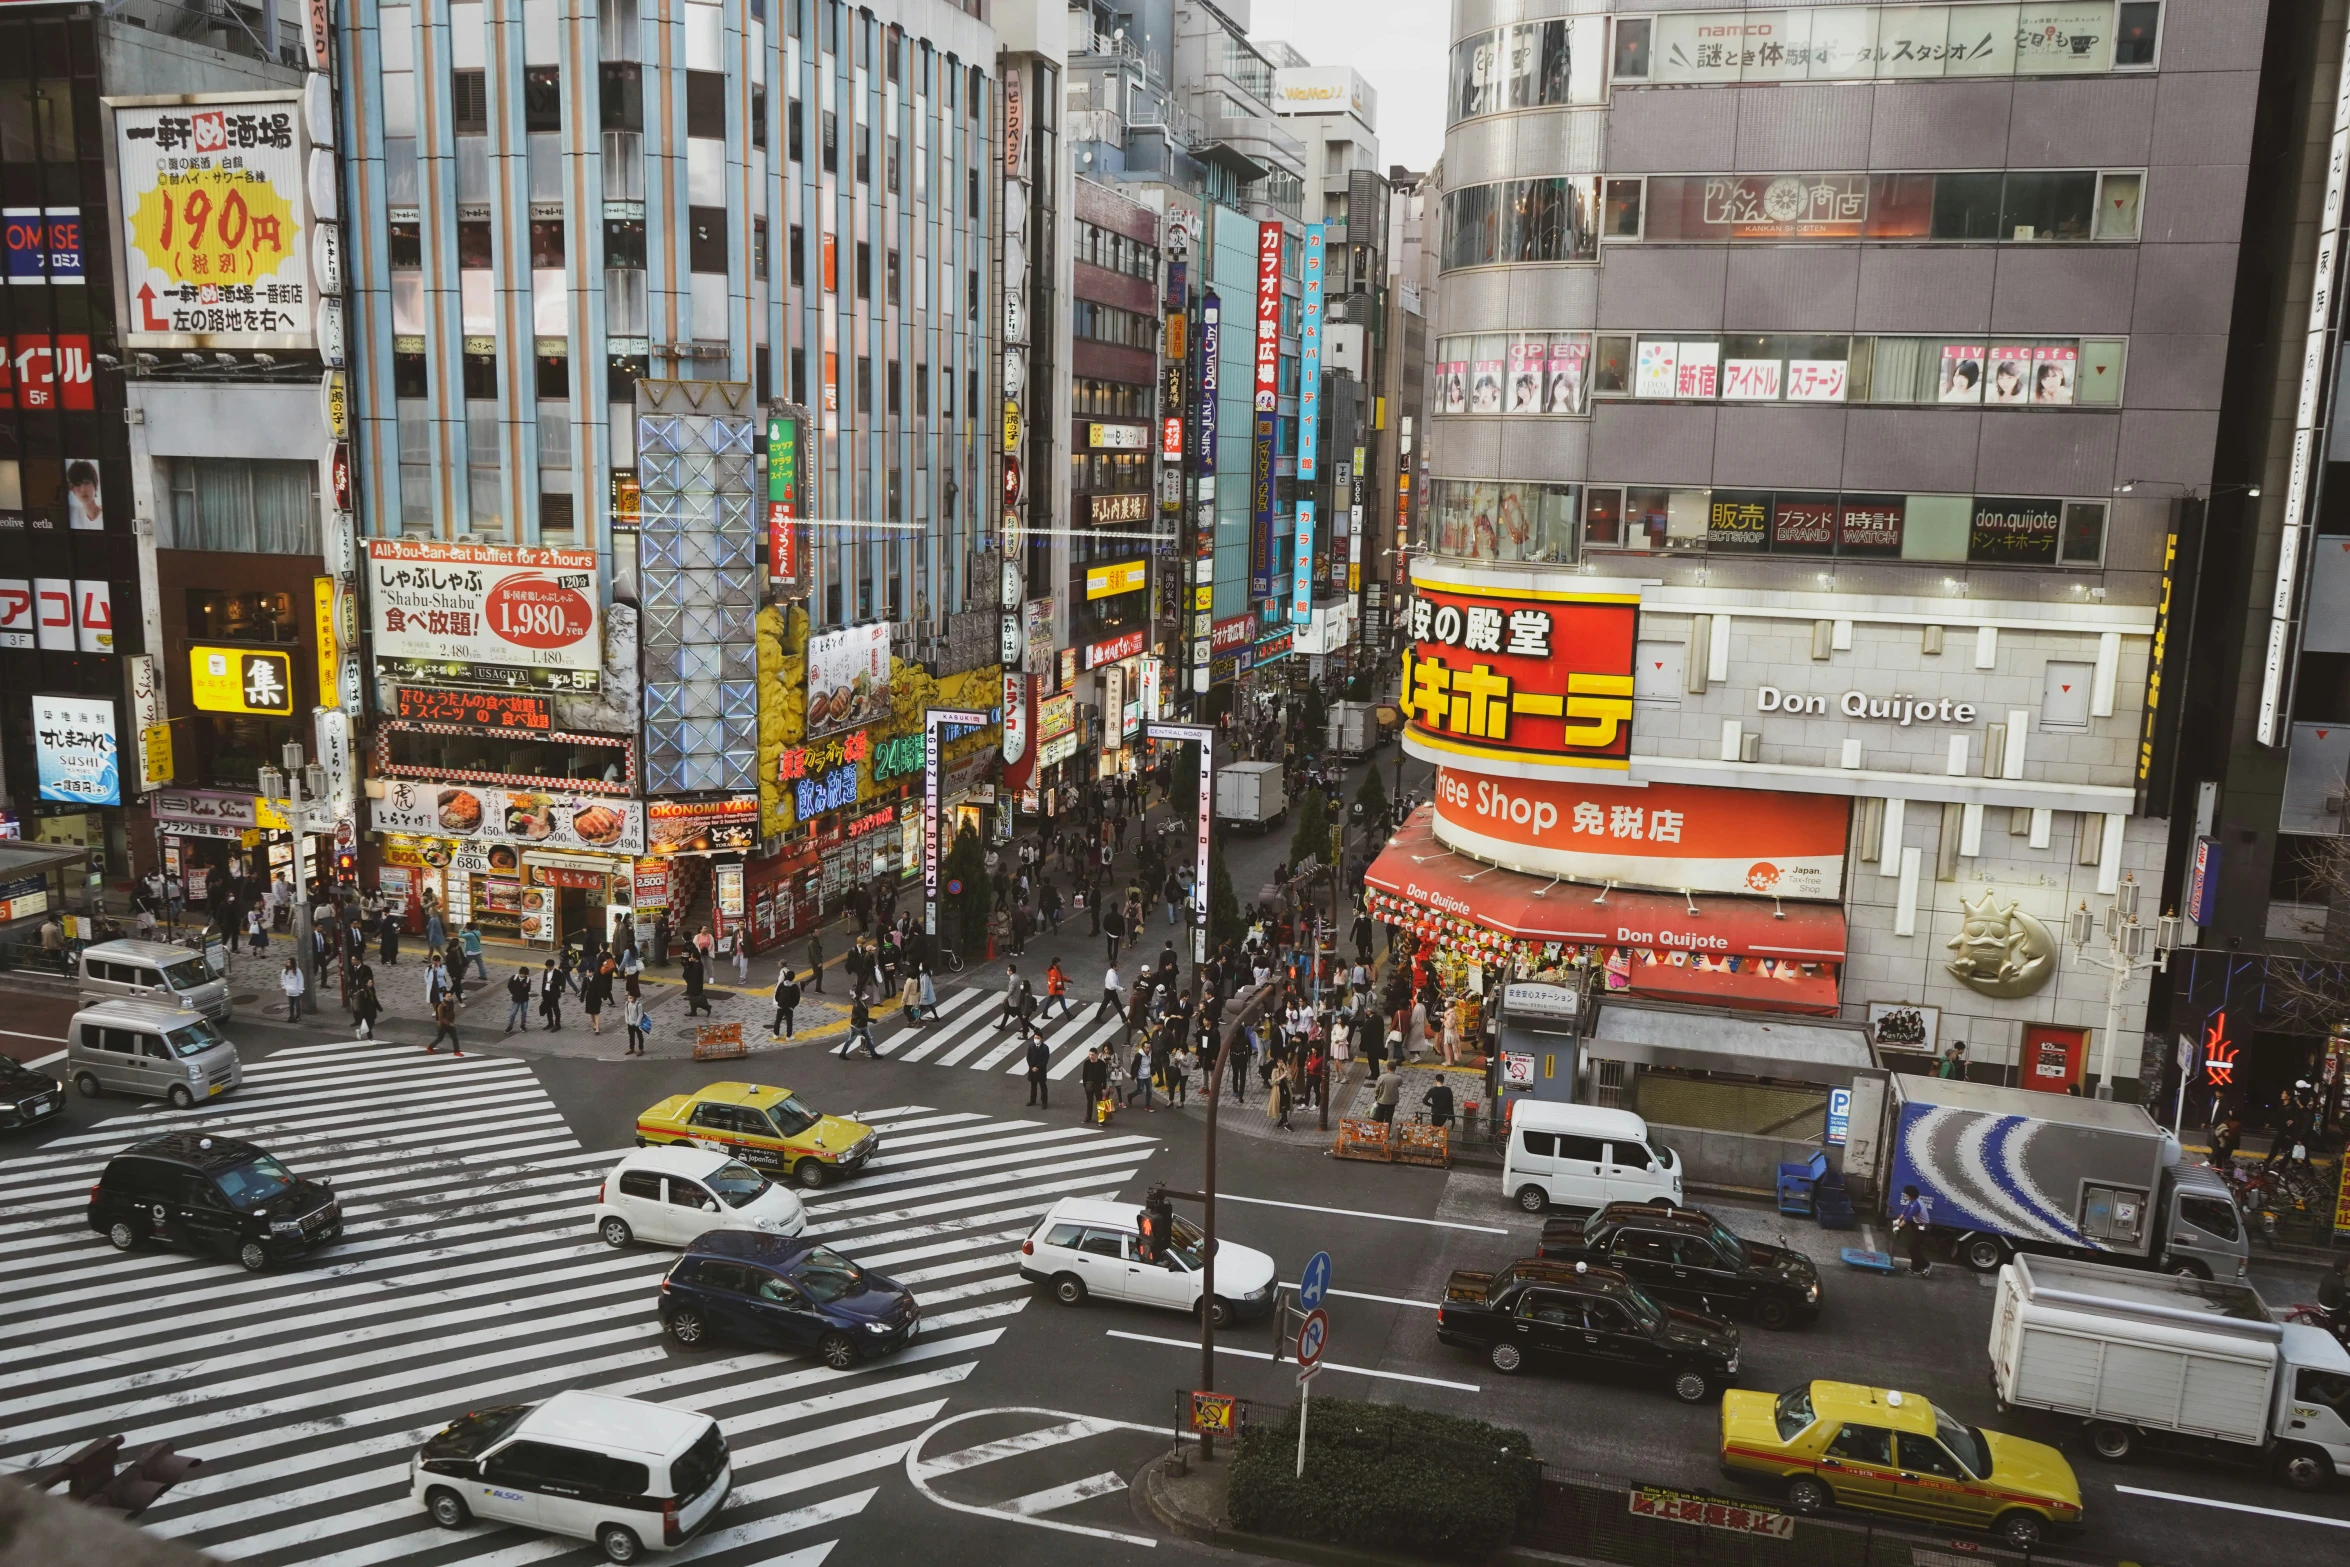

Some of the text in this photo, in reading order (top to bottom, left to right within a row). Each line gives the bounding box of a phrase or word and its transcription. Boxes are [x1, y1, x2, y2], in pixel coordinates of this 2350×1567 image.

[1698, 24, 1773, 37] namco
[159, 188, 282, 252] 190円
[1745, 224, 1781, 233] KANKAN
[1258, 228, 1279, 384] カラオケ歌広場
[173, 308, 295, 332] 左の路地を右へ
[1301, 234, 1320, 469] カラオケ&パーティー館
[1511, 344, 1587, 358] OPEN
[1678, 364, 1845, 397] 新宿 アイドル ステージ
[29, 390, 48, 405] 5F
[1006, 415, 1019, 440] 虎の子
[771, 471, 793, 480] スイーツ
[1711, 502, 1765, 531] 販売
[1777, 510, 1899, 531] ブランド 時計
[1777, 527, 1898, 545] BRAND WATCH
[540, 552, 550, 564] 2
[1296, 510, 1311, 613] カラオケ館
[380, 565, 484, 592] しゃぶしゃぶ
[499, 602, 584, 638] 1,980 yen
[1408, 594, 1551, 657] 安の殿堂
[9, 634, 26, 646] 3F
[244, 659, 284, 705] 集
[572, 672, 598, 689] 5F
[1005, 677, 1018, 731] トラノコ
[1399, 646, 1635, 749] キホーテ
[1757, 685, 1976, 727] Don Quijote
[1150, 728, 1202, 738] CENTRAL ROAD
[60, 755, 99, 768] SUSHI
[629, 803, 640, 837] かつ丼
[650, 800, 758, 818] OKONOMI YAKI
[1475, 780, 1558, 836] Shop
[1572, 801, 1684, 844] 免税店
[927, 832, 936, 871] ROAD
[1788, 876, 1822, 886] Tax-free
[1799, 884, 1821, 895] Shop
[1406, 882, 1470, 917] Don Quijote
[1616, 927, 1729, 951] Don Quijote
[1833, 1093, 1849, 1114] P
[748, 1154, 779, 1166] JapanTaxi
